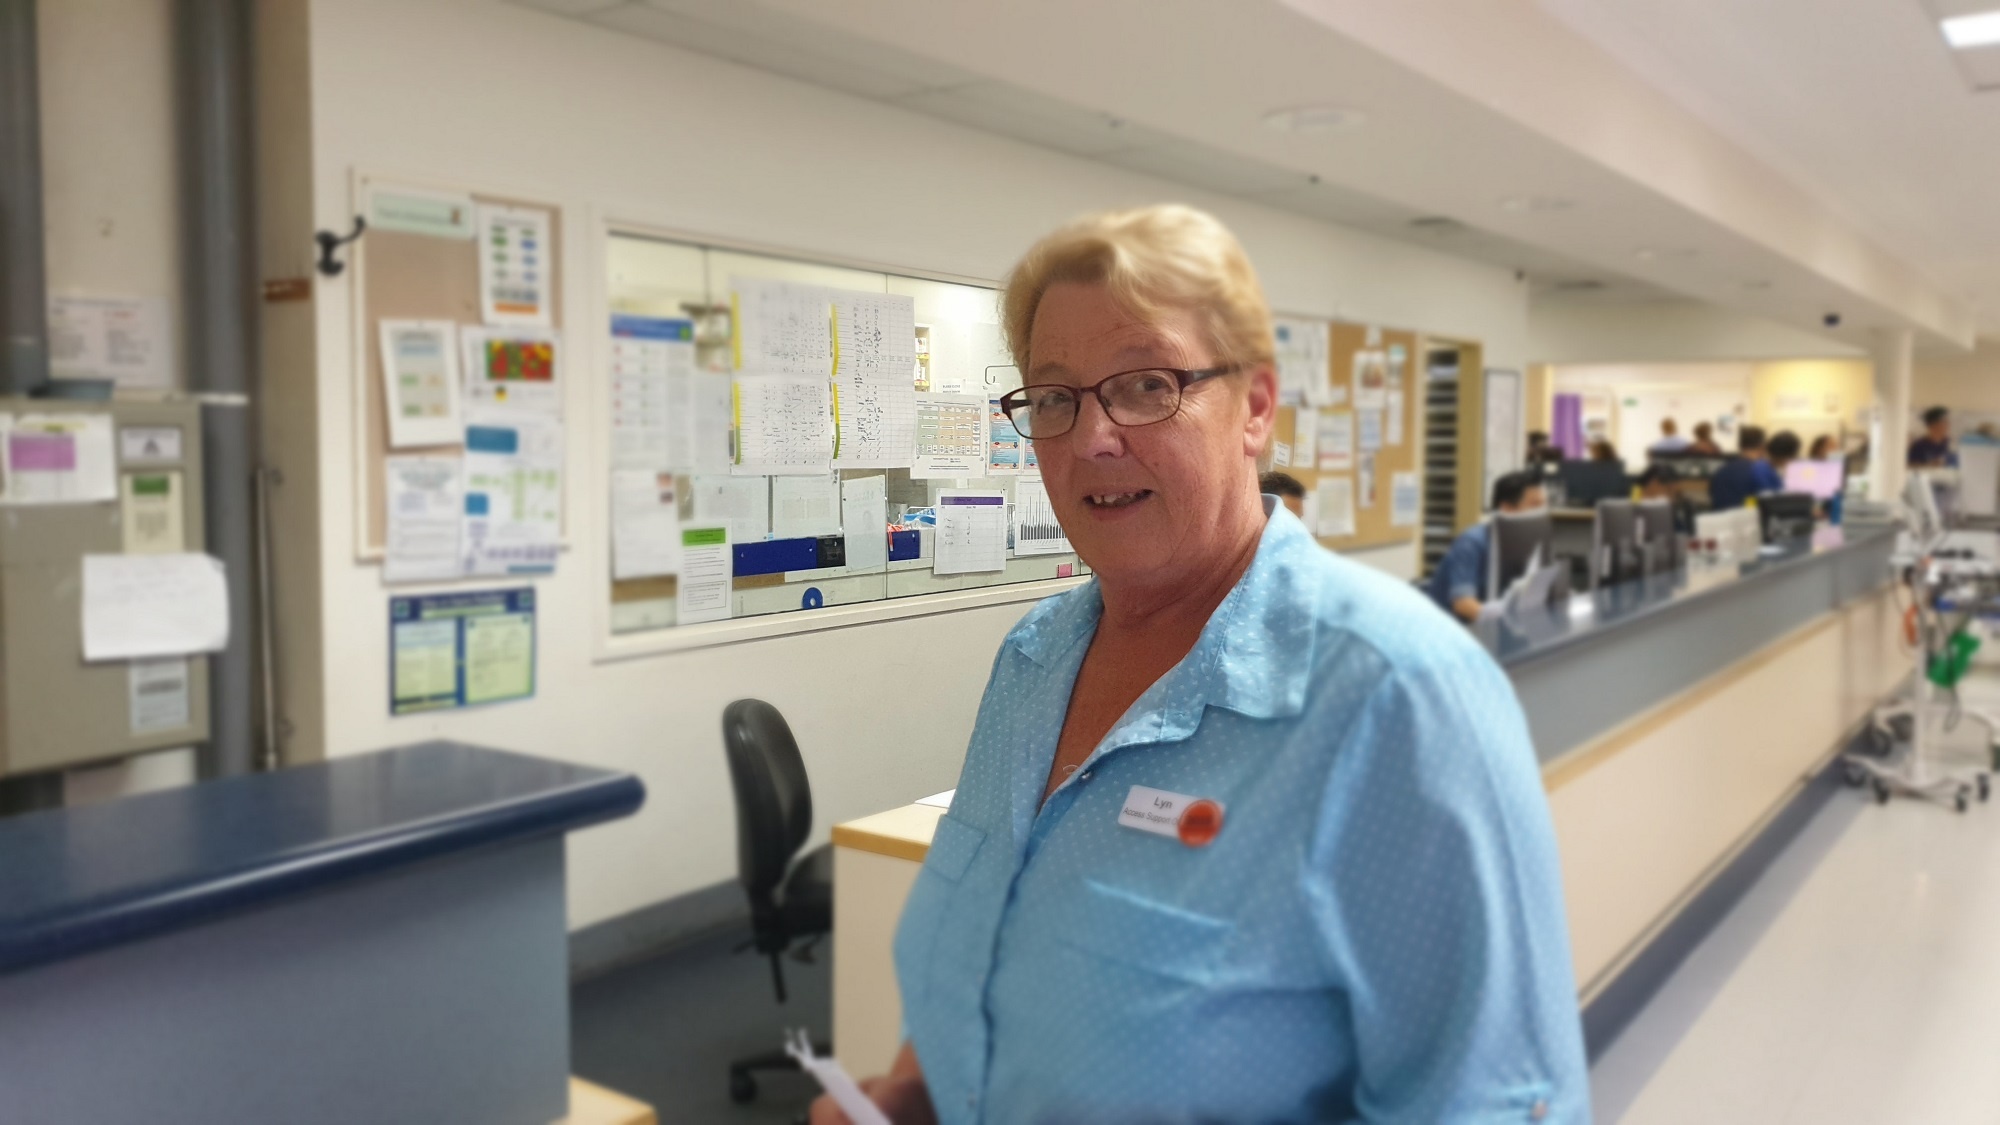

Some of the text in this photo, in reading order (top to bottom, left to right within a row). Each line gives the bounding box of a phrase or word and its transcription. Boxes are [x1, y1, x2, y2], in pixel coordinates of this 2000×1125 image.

[1153, 796, 1173, 809] Lyn
[1123, 807, 1145, 818] Access
[1146, 811, 1171, 825] Support
